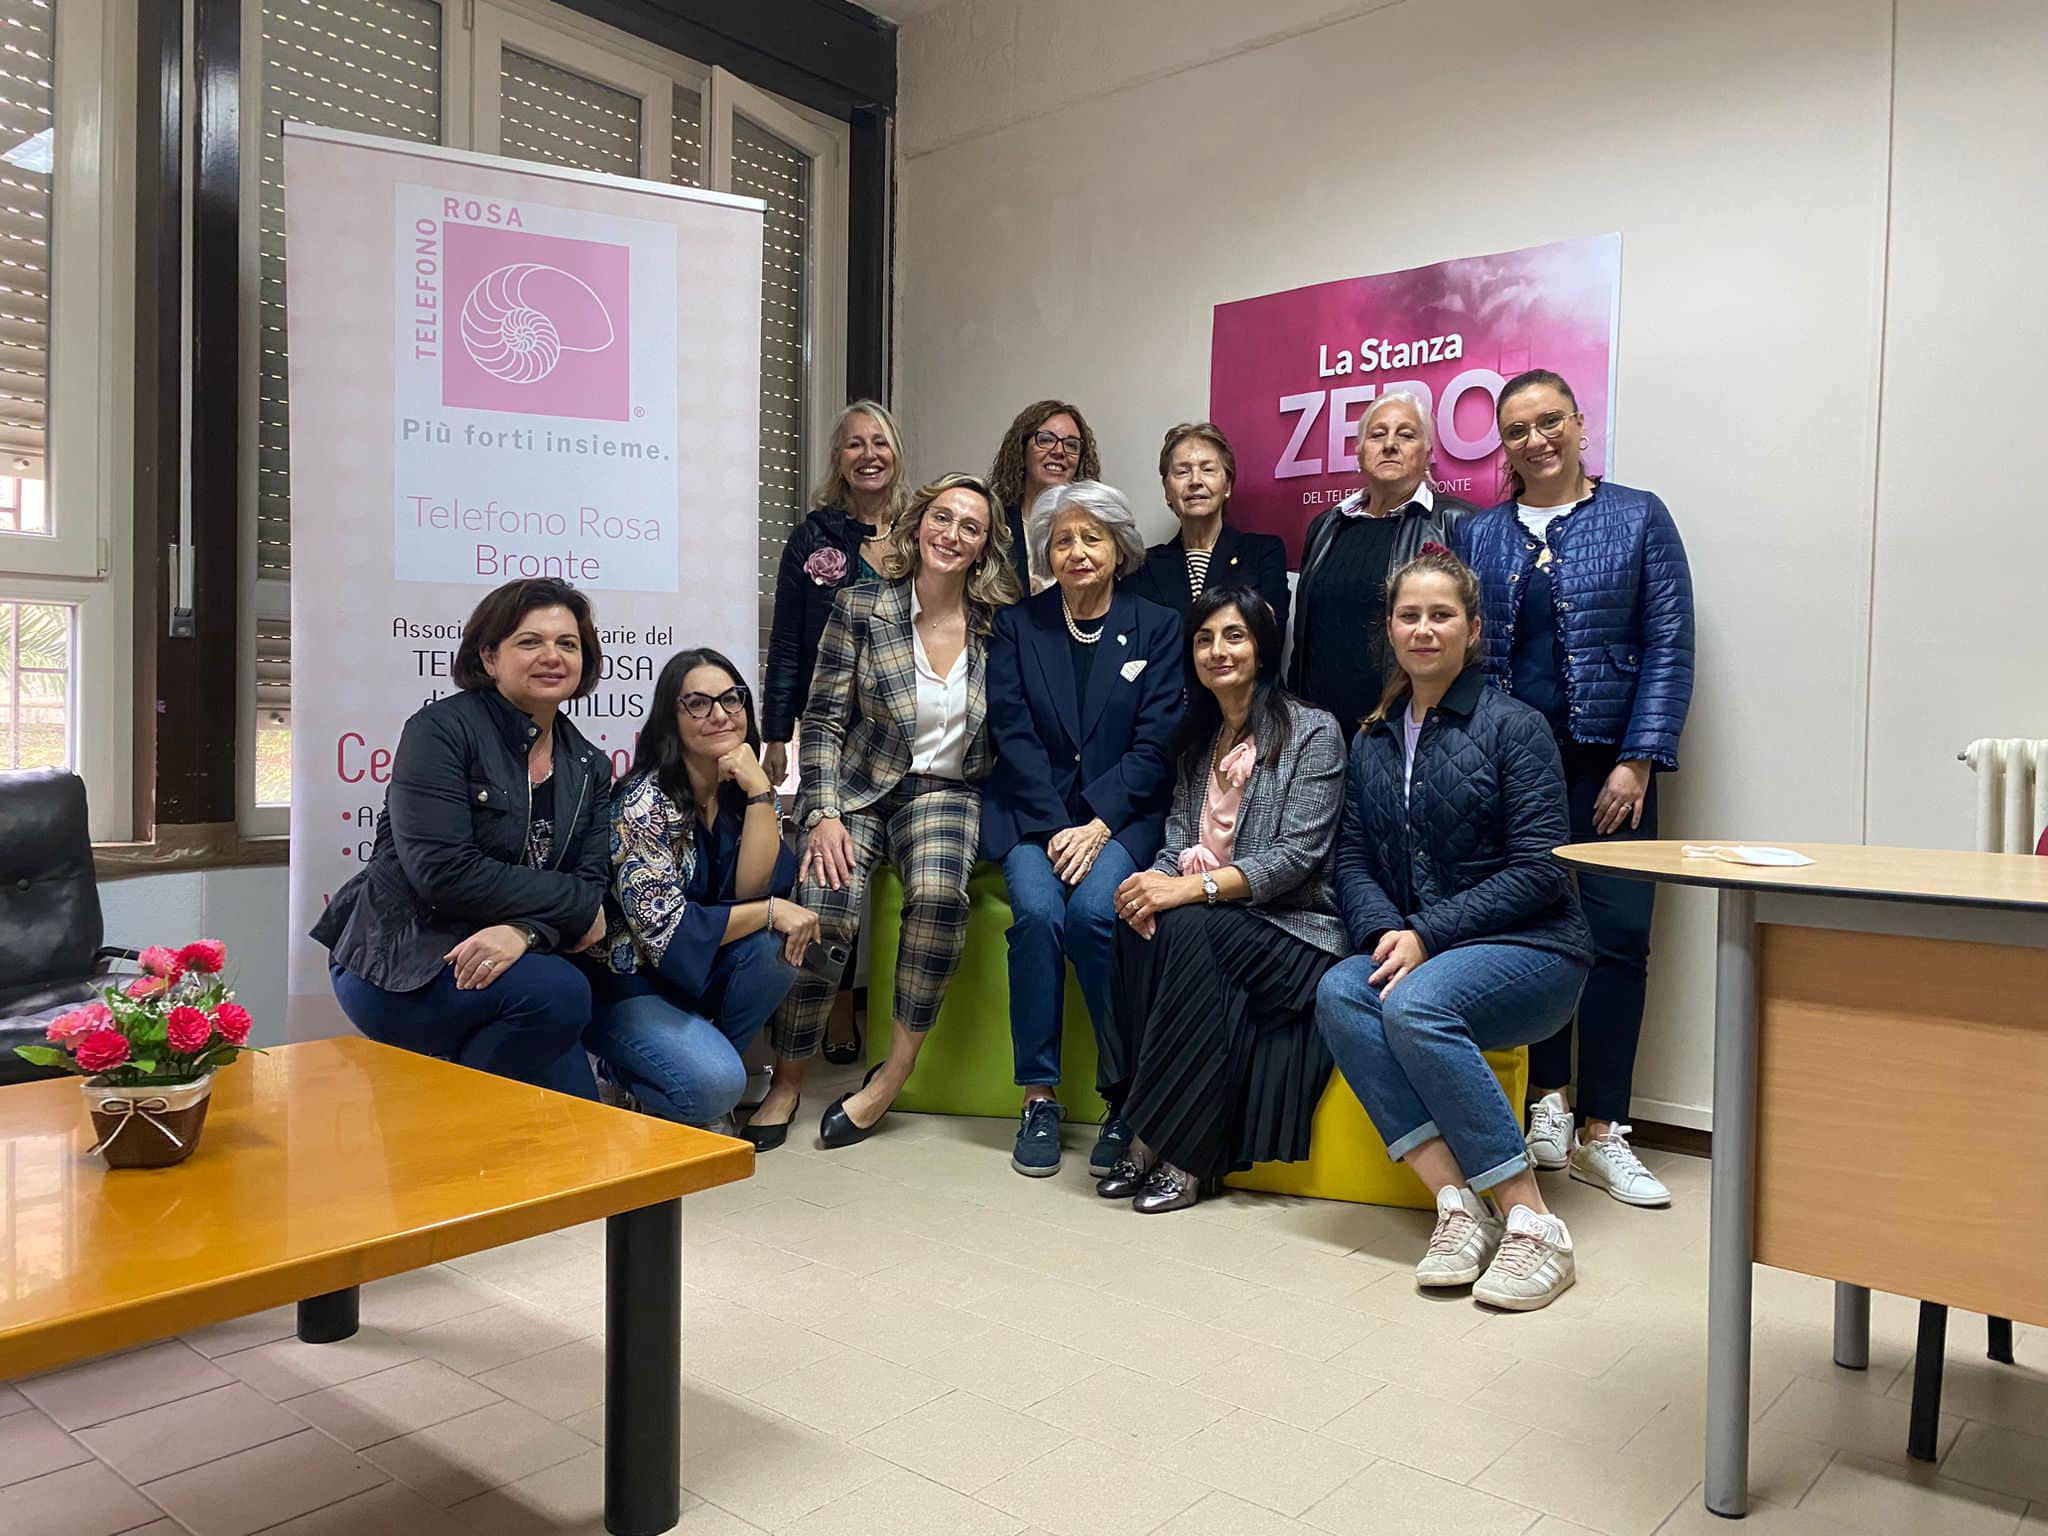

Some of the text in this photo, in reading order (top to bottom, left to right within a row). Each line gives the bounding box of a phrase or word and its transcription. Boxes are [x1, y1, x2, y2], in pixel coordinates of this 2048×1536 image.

[443, 196, 524, 228] ROSA
[415, 217, 438, 360] TELEFONO
[1318, 332, 1464, 378] La Stanza
[402, 418, 670, 461] Più forti insieme.
[1302, 491, 1324, 505] DEL
[1428, 477, 1472, 494] RONTE
[407, 495, 661, 542] Telefono Rosa
[475, 543, 600, 580] Bronte
[392, 616, 672, 646] Associ tarie del
[599, 654, 654, 681] OSA
